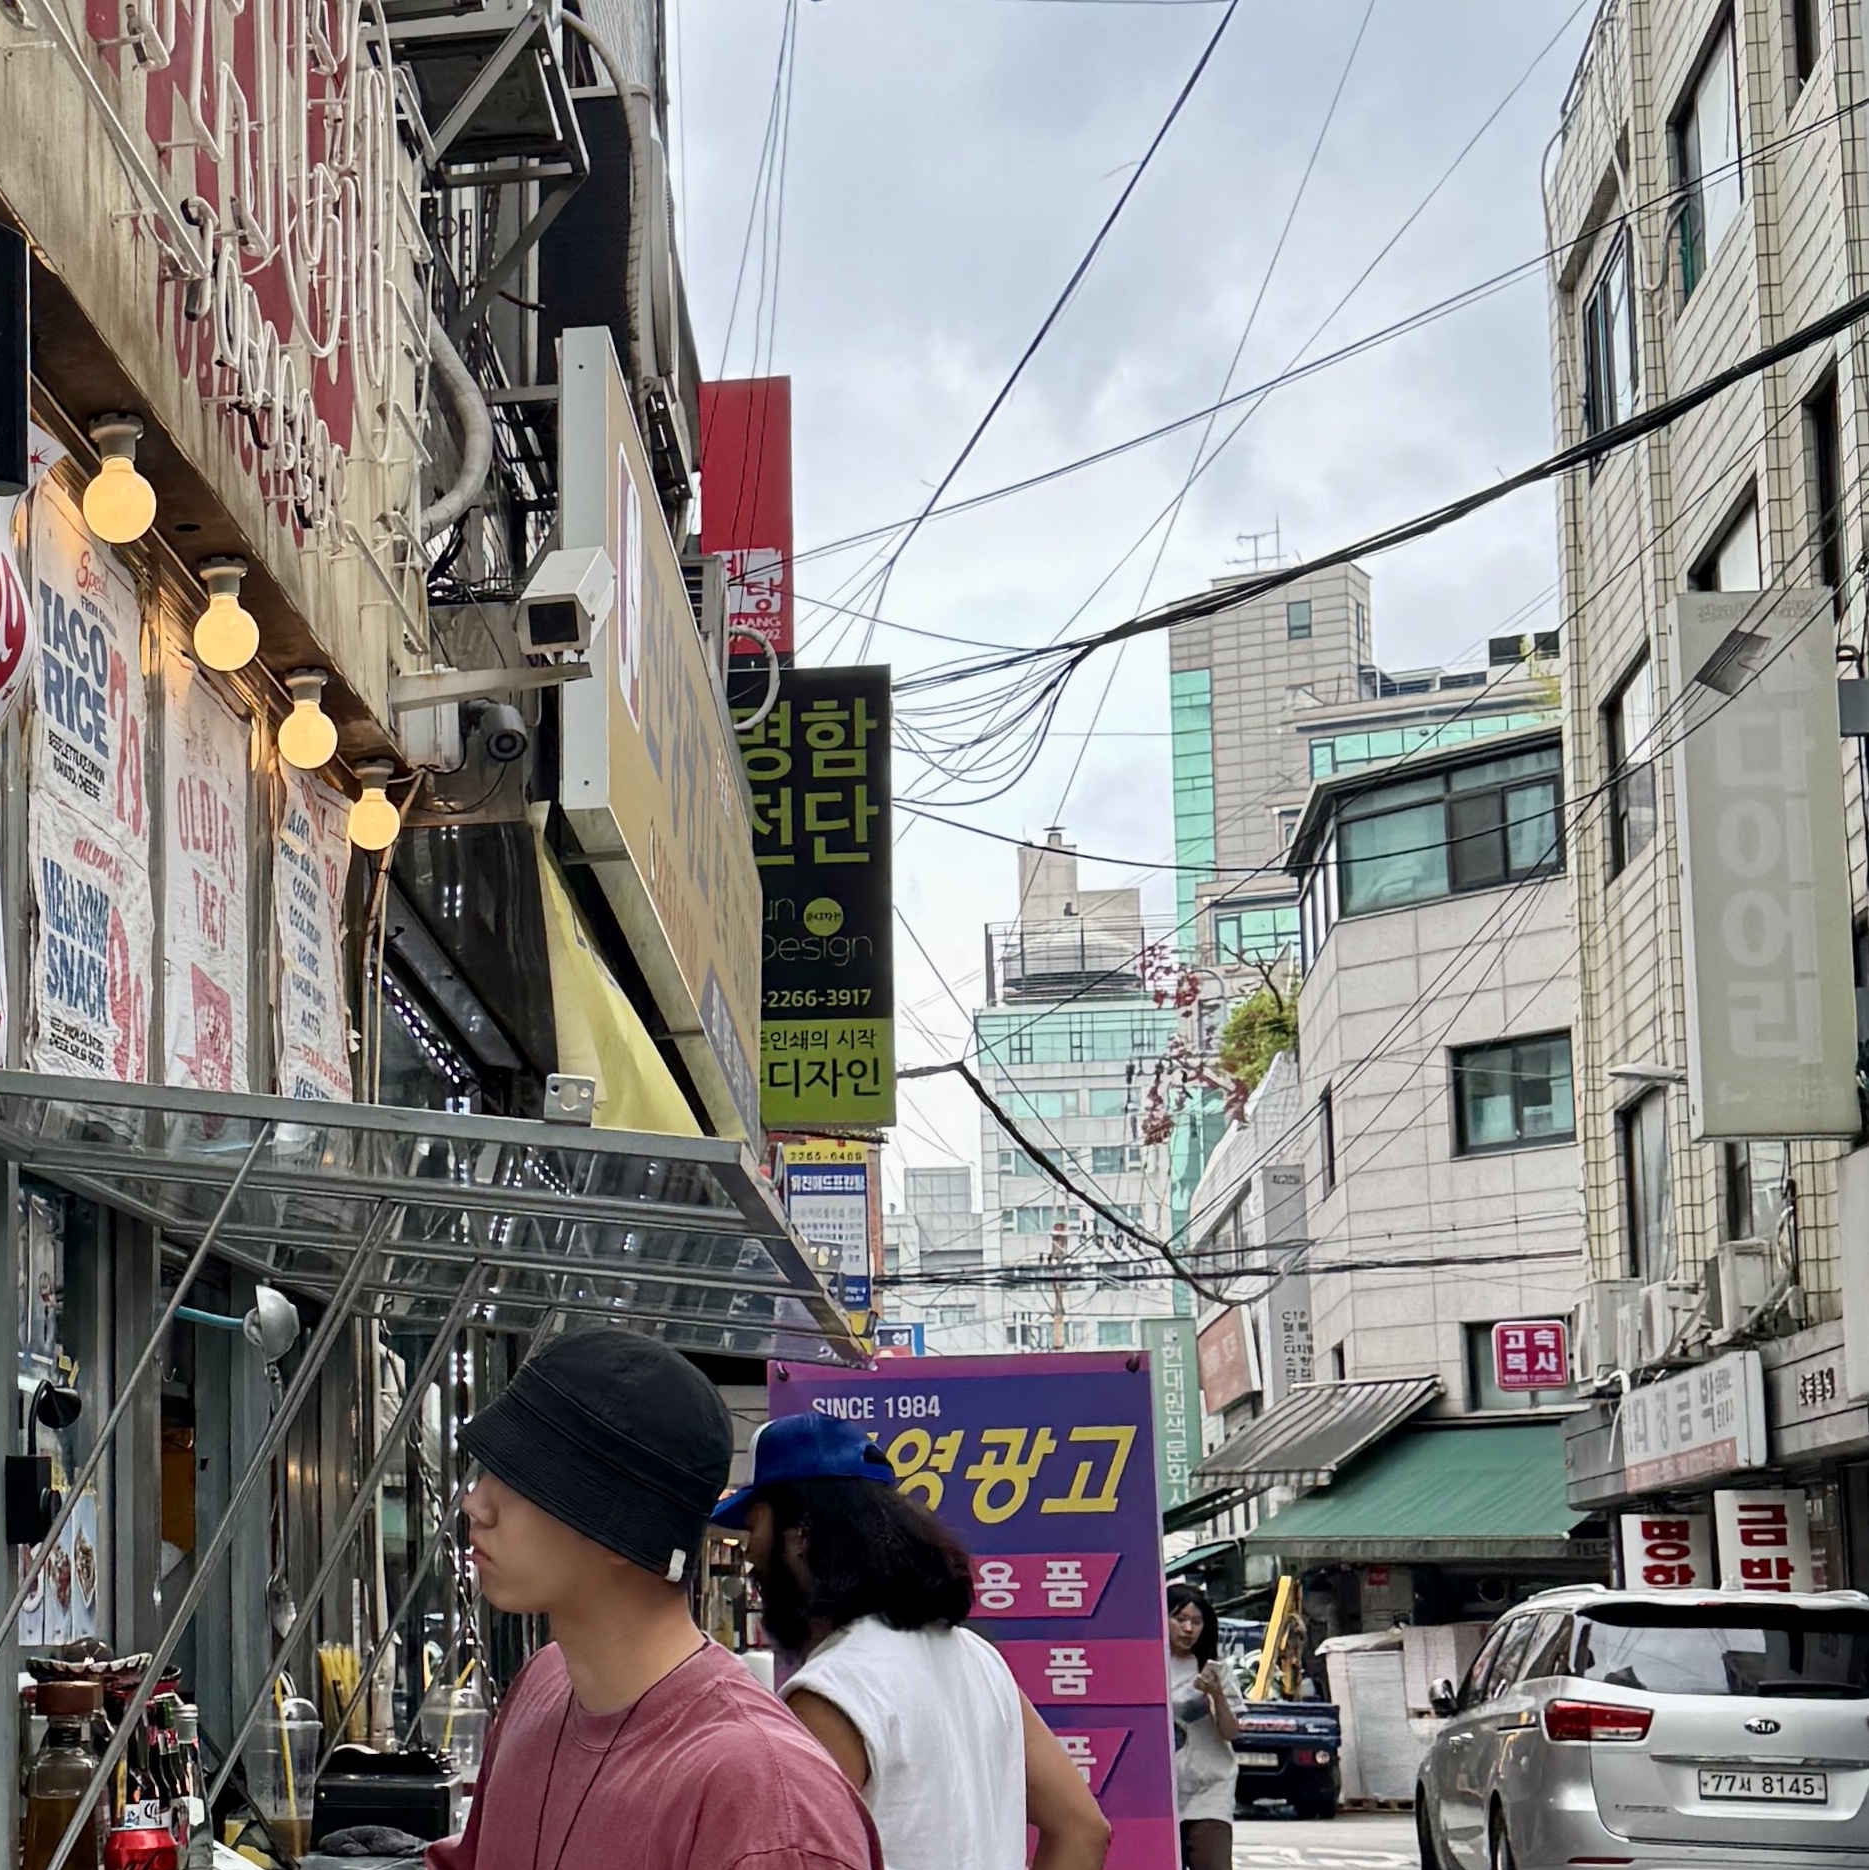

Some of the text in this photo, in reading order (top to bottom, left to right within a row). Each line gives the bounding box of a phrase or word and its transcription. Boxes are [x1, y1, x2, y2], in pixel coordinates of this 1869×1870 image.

[39, 578, 108, 689] TACO
[42, 647, 110, 760] RICE
[739, 696, 879, 782] 명함
[177, 774, 237, 894] OLDIES
[192, 867, 228, 952] TACO
[46, 932, 109, 1028] SNACK
[759, 1057, 881, 1100] 디자인
[836, 1027, 878, 1051] 시작
[1504, 1329, 1556, 1350] 고속
[812, 1395, 942, 1420] SINCE 1984
[866, 1425, 1137, 1524] 영광고
[1045, 1647, 1093, 1696] 품
[1762, 1775, 1816, 1797] 8145
